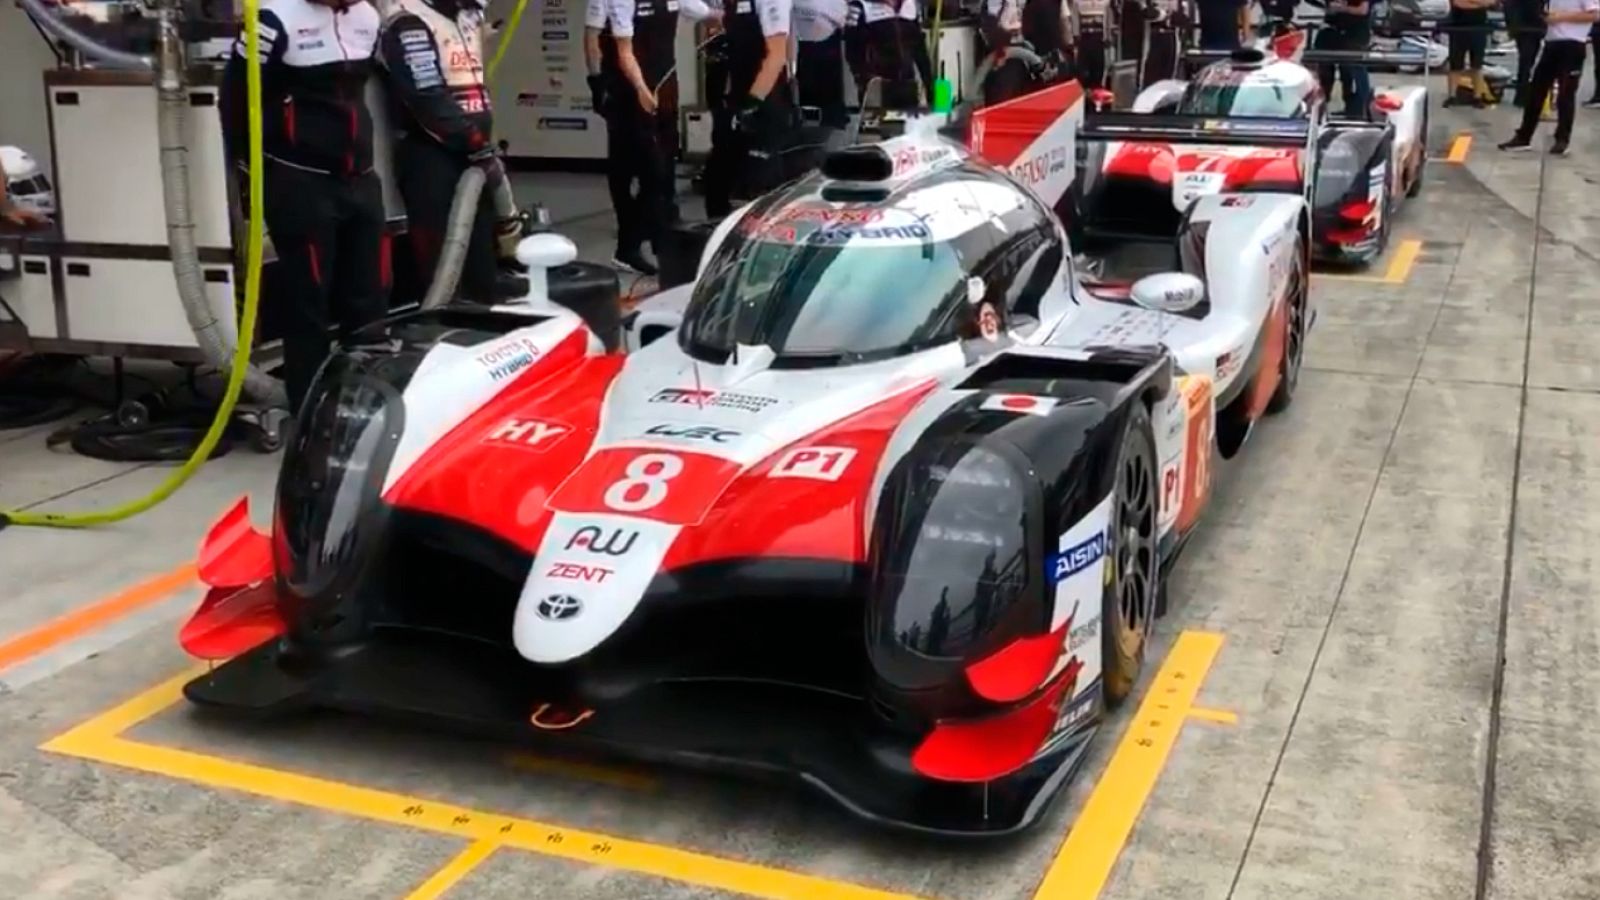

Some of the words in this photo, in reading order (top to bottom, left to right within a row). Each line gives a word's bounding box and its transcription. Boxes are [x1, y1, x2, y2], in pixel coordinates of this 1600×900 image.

[488, 352, 534, 381] HYBRID
[489, 420, 566, 444] HY
[645, 424, 742, 442] WEC
[782, 452, 843, 473] P1
[604, 453, 685, 512] 8
[564, 525, 640, 556] AW
[1055, 537, 1103, 578] AISIN
[546, 562, 615, 583] ZENT
